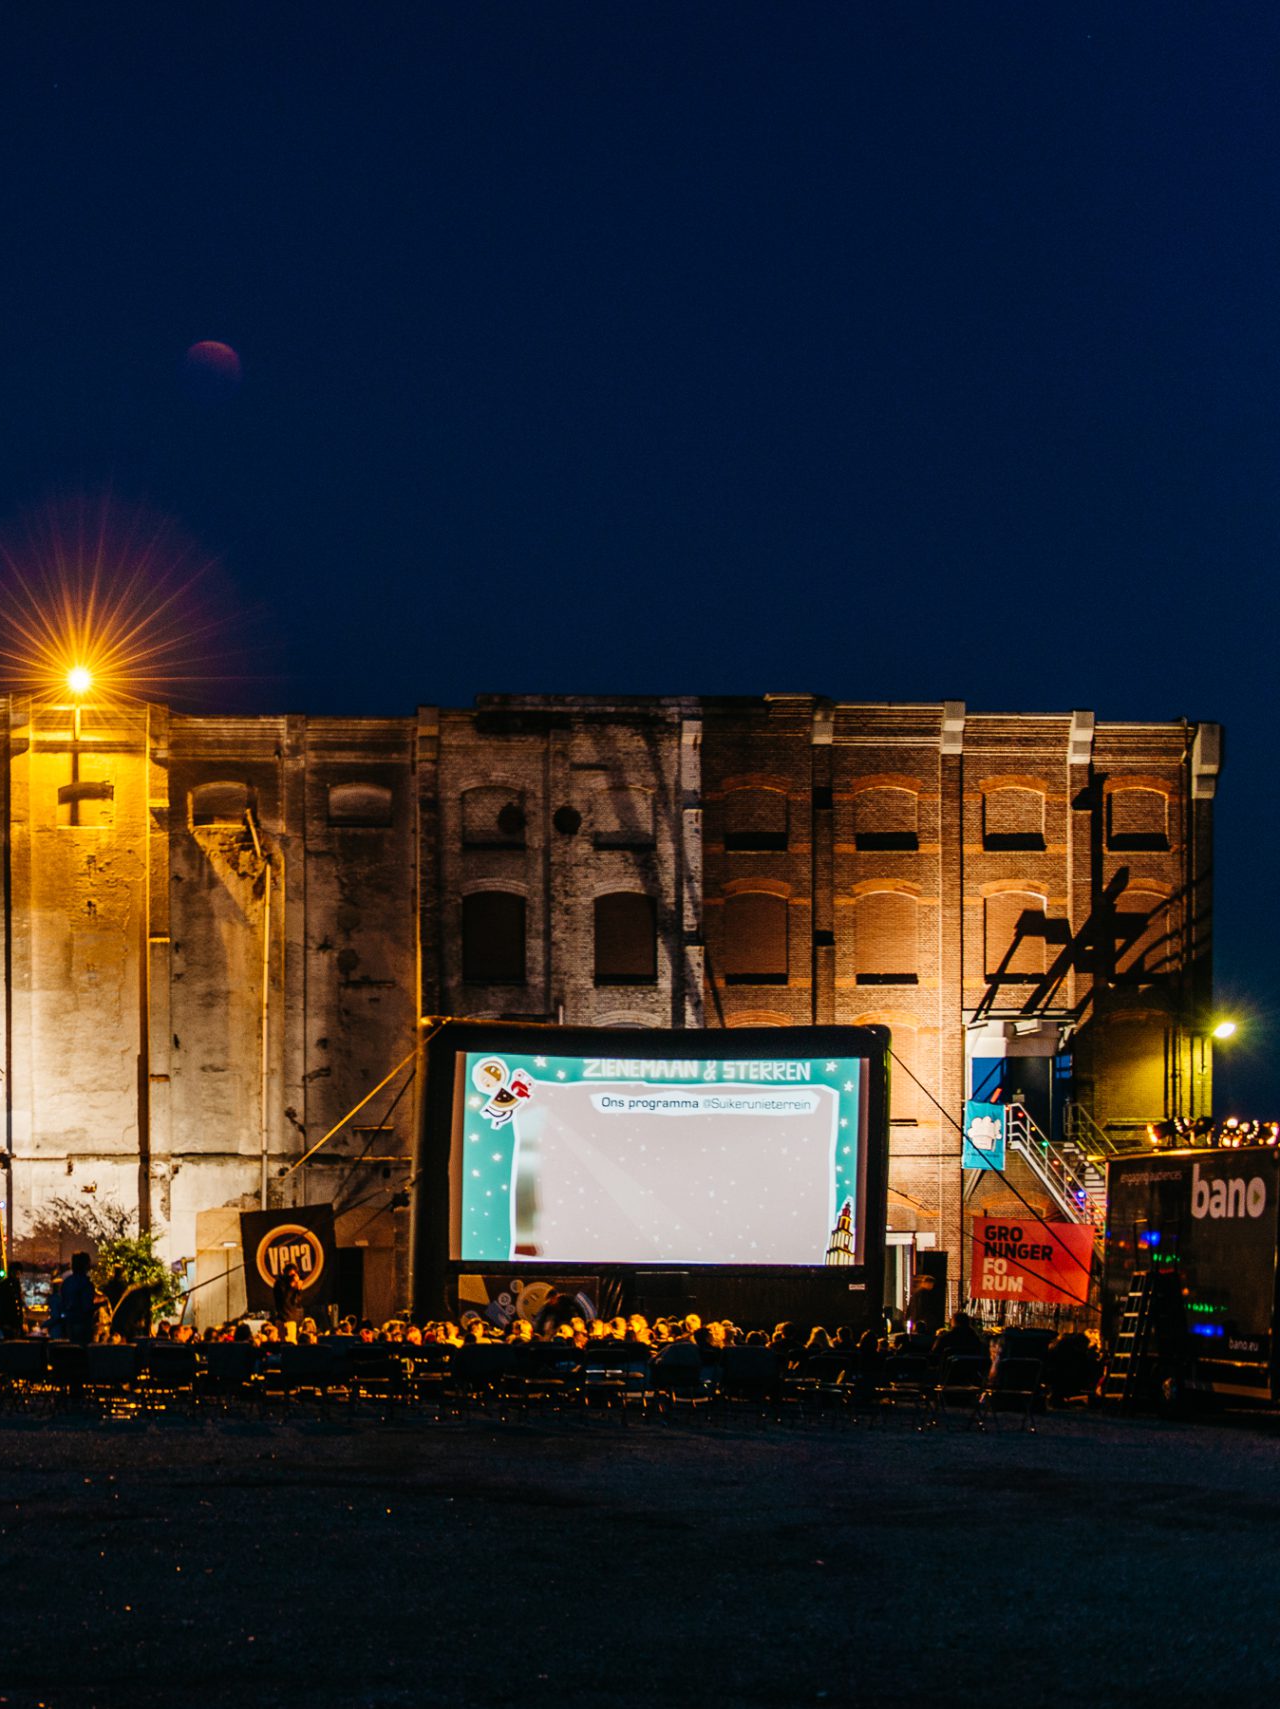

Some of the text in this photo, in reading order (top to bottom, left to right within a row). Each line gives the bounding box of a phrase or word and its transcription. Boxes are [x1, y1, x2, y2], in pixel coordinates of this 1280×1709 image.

[582, 1059, 811, 1081] ZIENEMAAN & STERREN
[601, 1096, 625, 1109] Ons
[628, 1099, 699, 1111] programma
[1191, 1163, 1266, 1219] bano
[984, 1225, 1023, 1242] GRO
[268, 1243, 312, 1275] vera
[984, 1241, 1054, 1262] NINGER
[983, 1257, 1008, 1275] FO
[982, 1274, 1024, 1293] RUM
